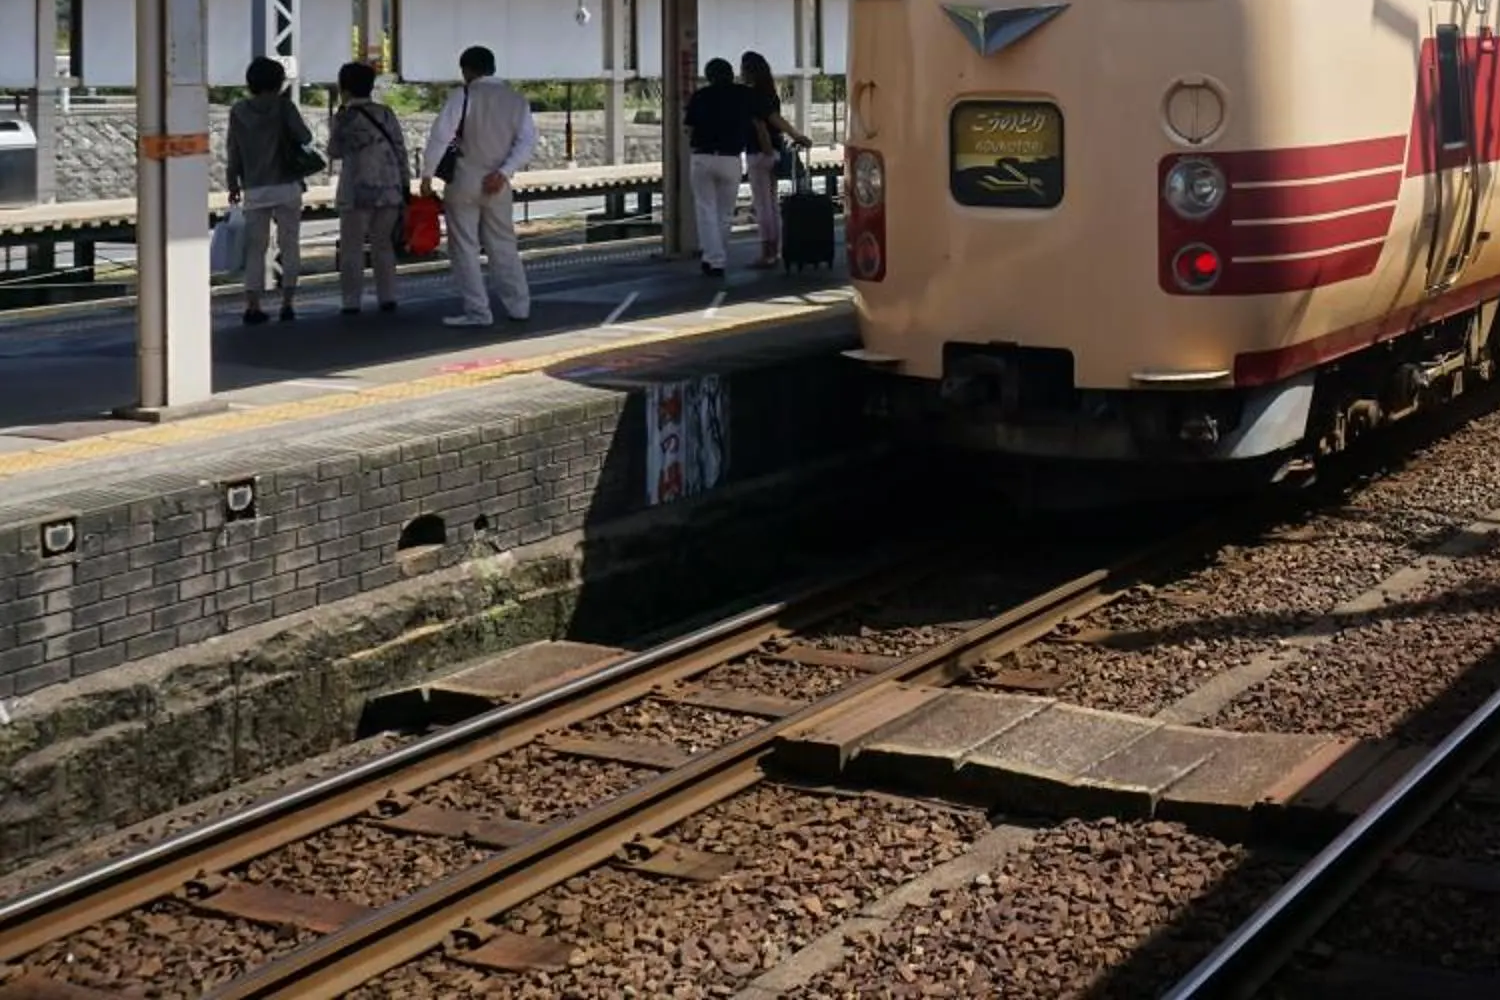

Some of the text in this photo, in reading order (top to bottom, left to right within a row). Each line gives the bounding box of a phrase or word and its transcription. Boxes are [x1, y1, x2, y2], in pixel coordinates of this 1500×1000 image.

[971, 111, 1046, 133] こうのとり
